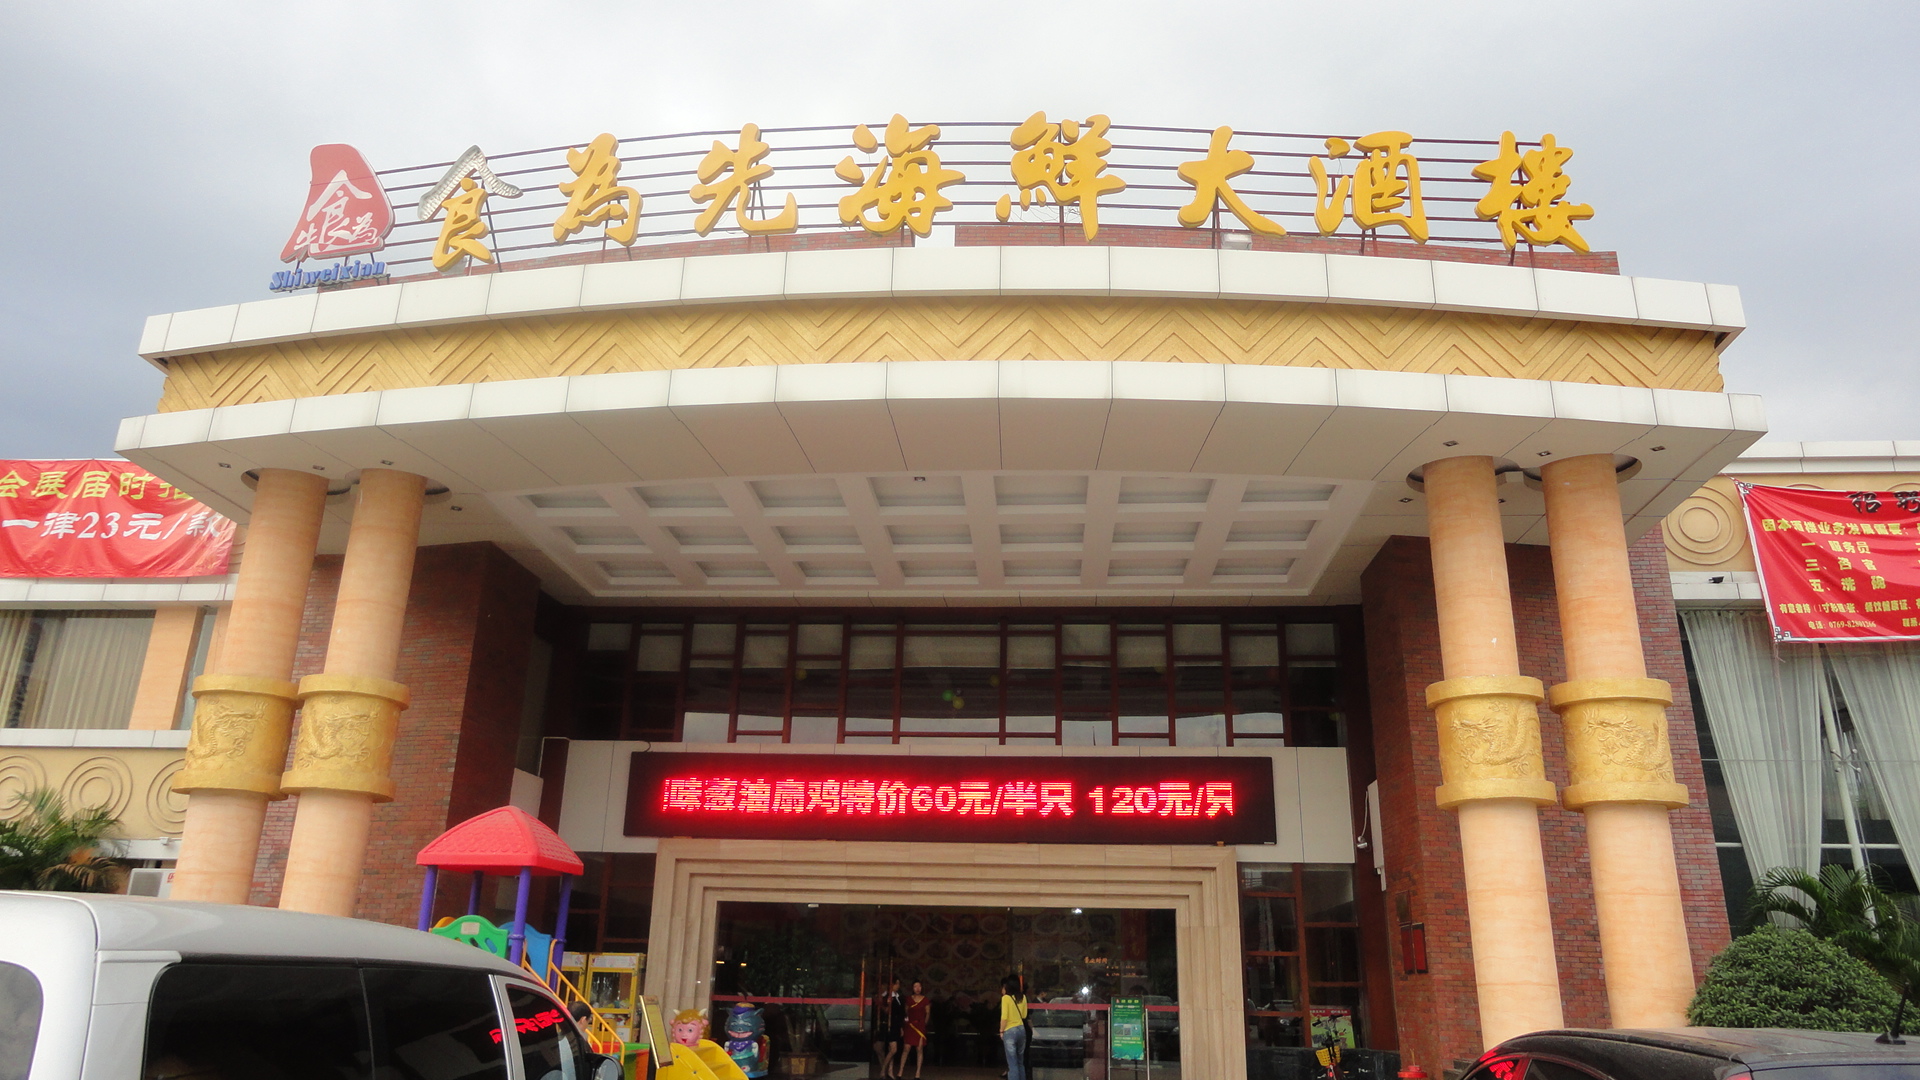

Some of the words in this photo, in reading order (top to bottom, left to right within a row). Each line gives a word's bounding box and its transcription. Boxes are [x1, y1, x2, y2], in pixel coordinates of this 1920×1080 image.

[269, 260, 387, 291] Shiweixian
[2, 511, 223, 540] 一律23元/款
[1088, 781, 1234, 818] 120元/只
